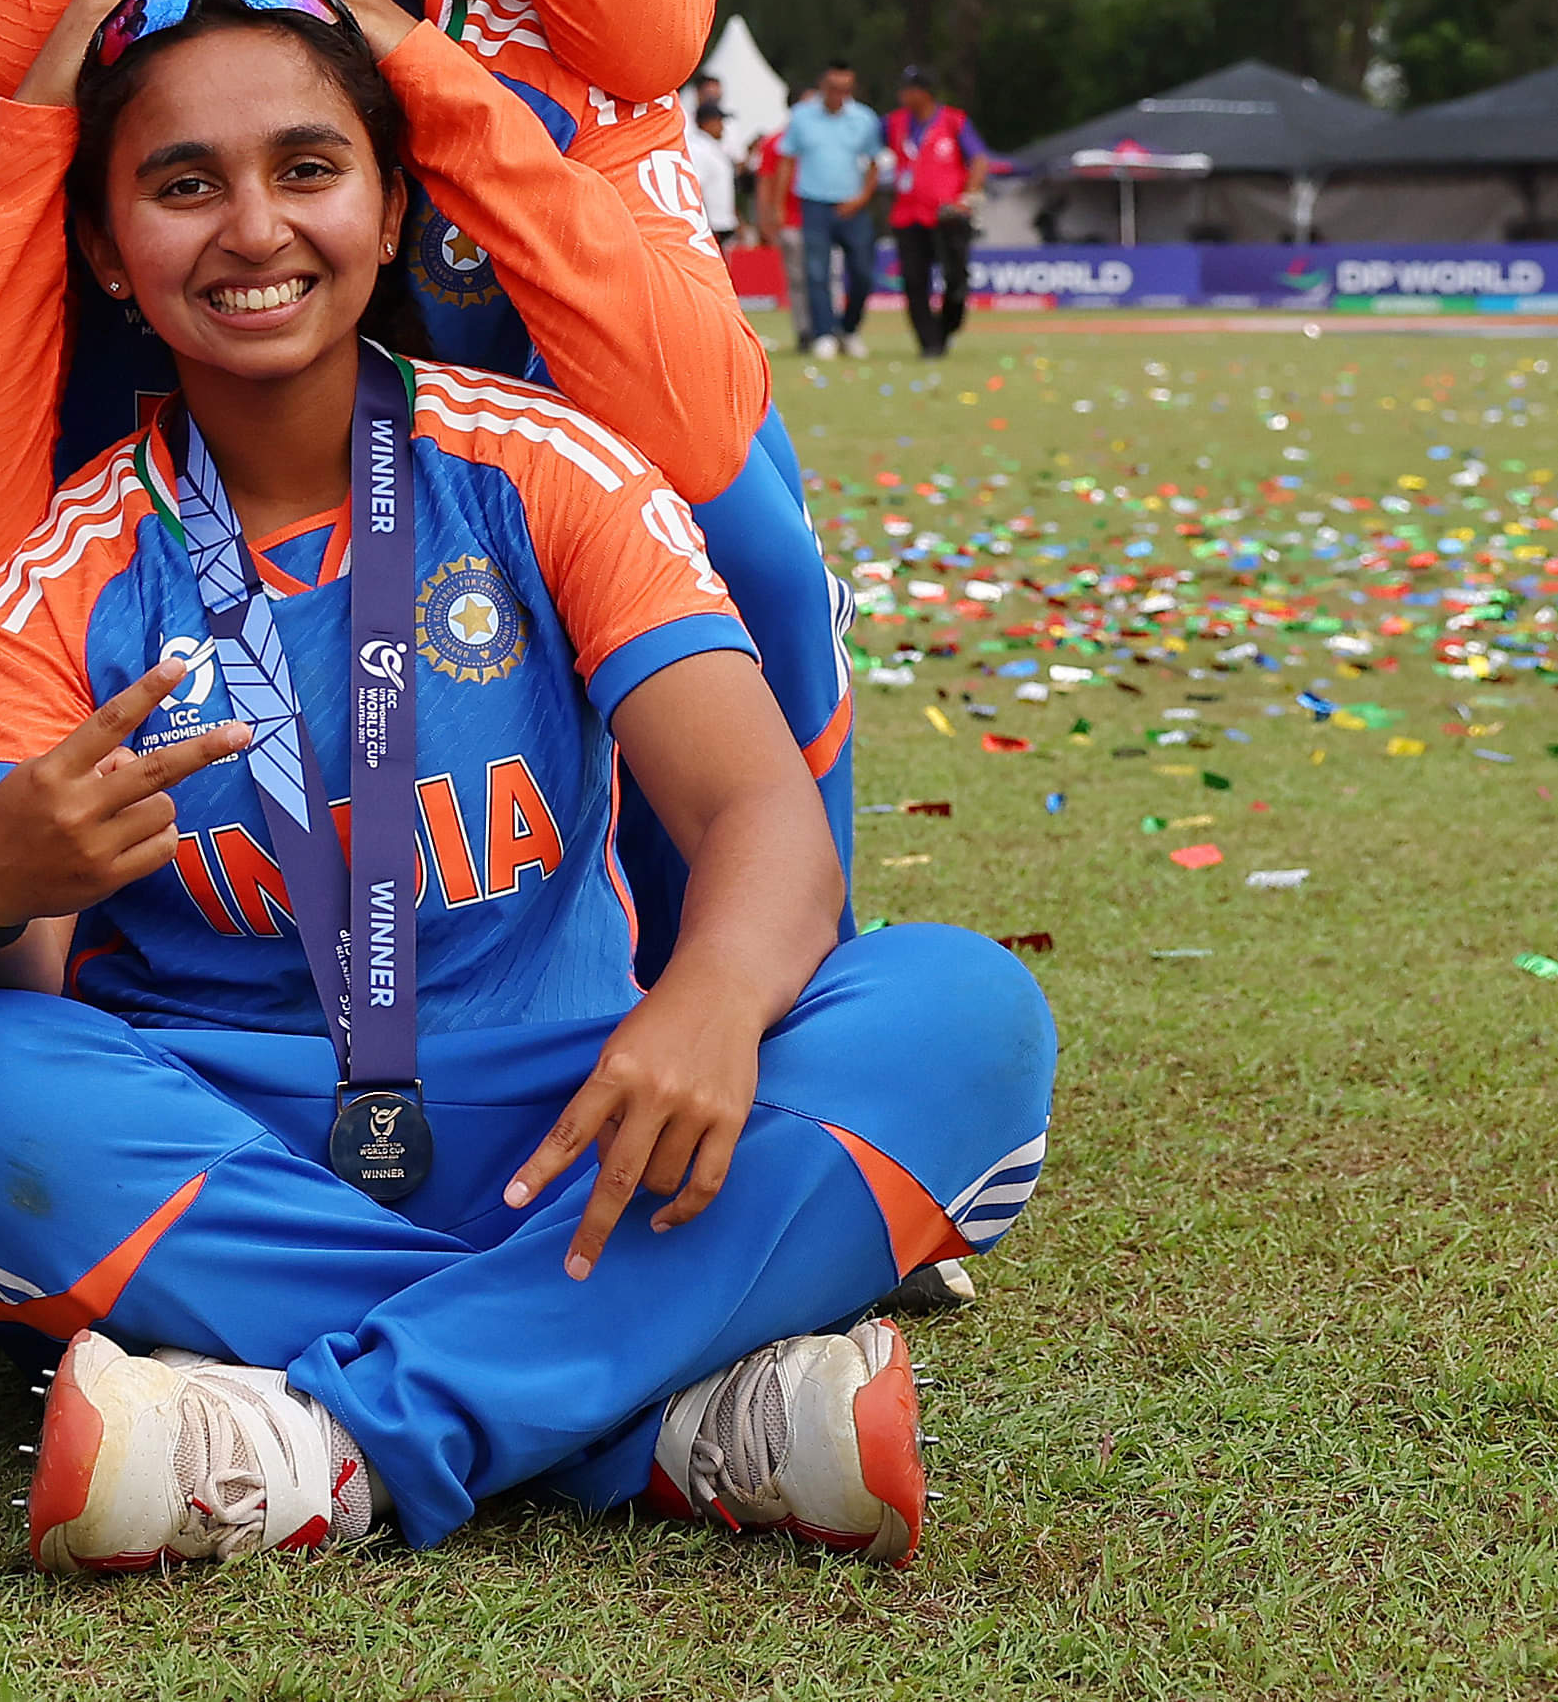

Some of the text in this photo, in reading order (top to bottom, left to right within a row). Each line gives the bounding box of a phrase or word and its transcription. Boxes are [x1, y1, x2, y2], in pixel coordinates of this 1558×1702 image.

[989, 261, 1133, 294] WORLD
[1337, 260, 1545, 294] DP WORLD
[371, 419, 396, 534] WINNER
[358, 687, 366, 725] MALAYSIA
[387, 688, 398, 709] ICC
[170, 708, 201, 728] ICC
[366, 687, 379, 769] WORLD CUP
[378, 703, 386, 740] WOMEN'S
[142, 734, 160, 747] U19
[370, 880, 396, 1008] WINNER
[389, 1146, 406, 1155] CUP
[361, 1169, 405, 1180] WINNER
